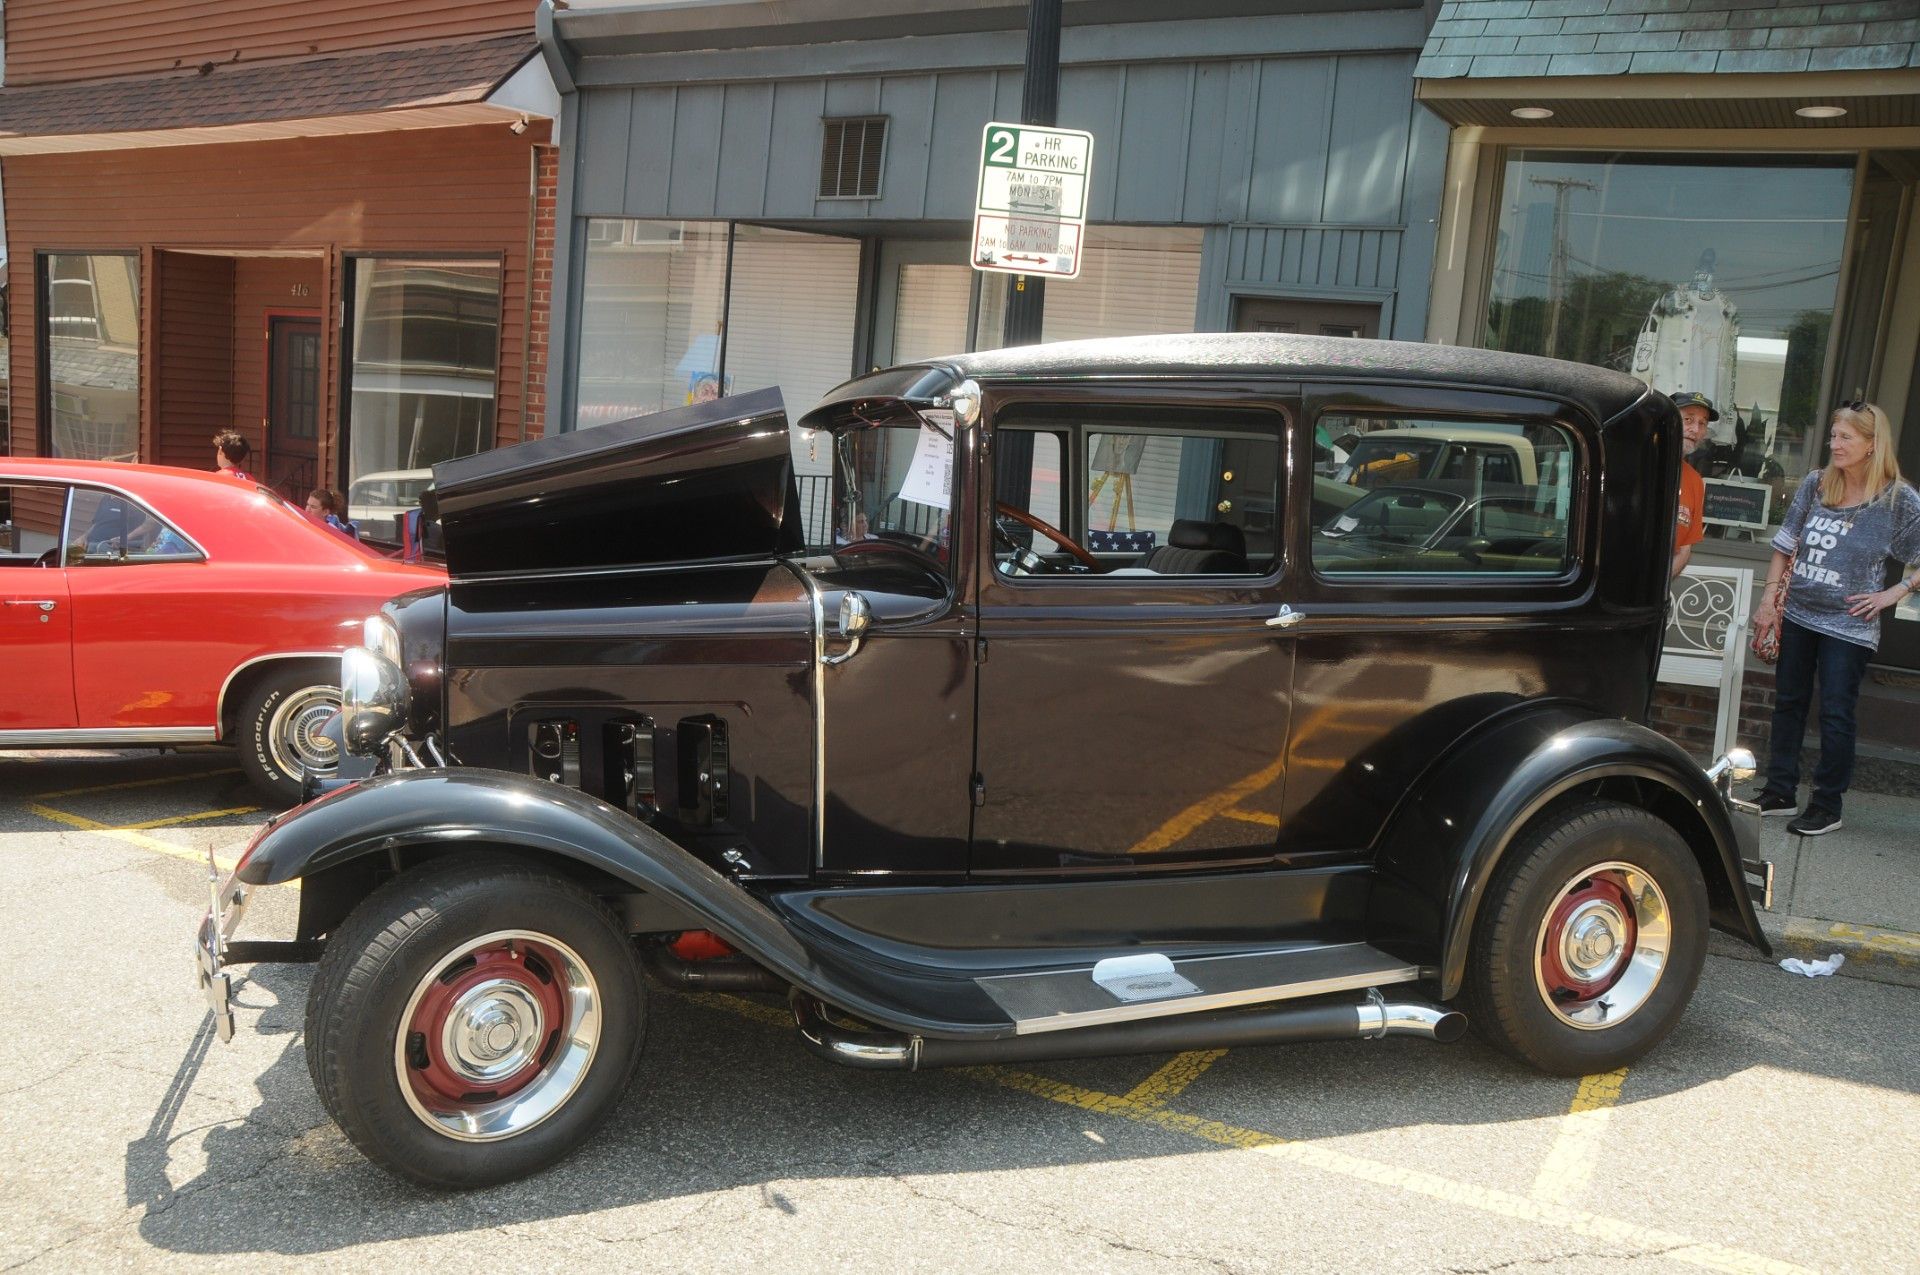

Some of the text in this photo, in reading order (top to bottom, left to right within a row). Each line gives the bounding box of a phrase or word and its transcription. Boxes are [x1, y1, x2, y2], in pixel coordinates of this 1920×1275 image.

[989, 130, 1015, 164] 2
[1044, 137, 1062, 150] HR
[1024, 152, 1078, 169] PARKING
[1006, 171, 1063, 186] 7AM to 7PM
[1004, 224, 1053, 239] NO PARKING
[979, 236, 996, 248] 2AM
[1010, 239, 1026, 250] 6AM
[1805, 515, 1854, 536] JUST
[1805, 530, 1838, 550] DO
[1807, 548, 1827, 564] IT
